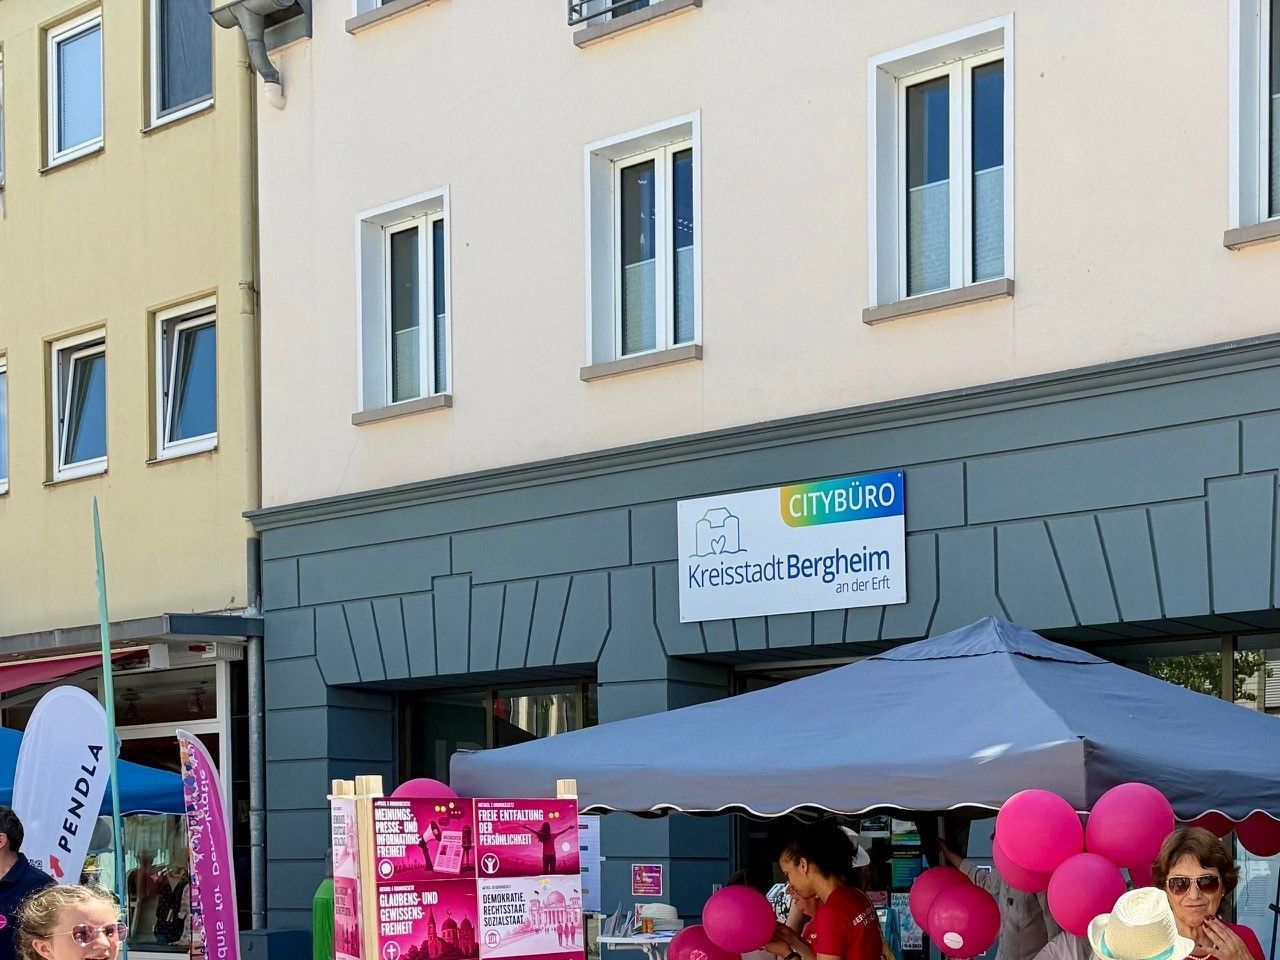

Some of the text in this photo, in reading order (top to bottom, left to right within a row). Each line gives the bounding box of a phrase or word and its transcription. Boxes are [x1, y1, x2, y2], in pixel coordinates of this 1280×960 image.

[789, 481, 895, 518] CITYBÜRO
[688, 545, 890, 589] Kreisstadt Bergheim
[835, 575, 891, 594] an der Erft
[58, 743, 103, 853] PENDLA
[478, 809, 544, 821] FREIE ENTFALTUNG
[376, 821, 418, 833] PRESSE- UND
[479, 822, 493, 834] DER
[479, 833, 532, 846] PERSÖNLICHKEIT
[377, 845, 406, 858] FREIHEIT
[379, 891, 438, 907] GLAUBENS- UND
[483, 892, 525, 904] DEMOKRATIE.
[380, 906, 425, 921] GEWISSENS-
[483, 904, 526, 915] RECHTSSTAAT.
[484, 915, 526, 927] SOZIALSTAAT.
[381, 921, 413, 936] FREIHEIT
